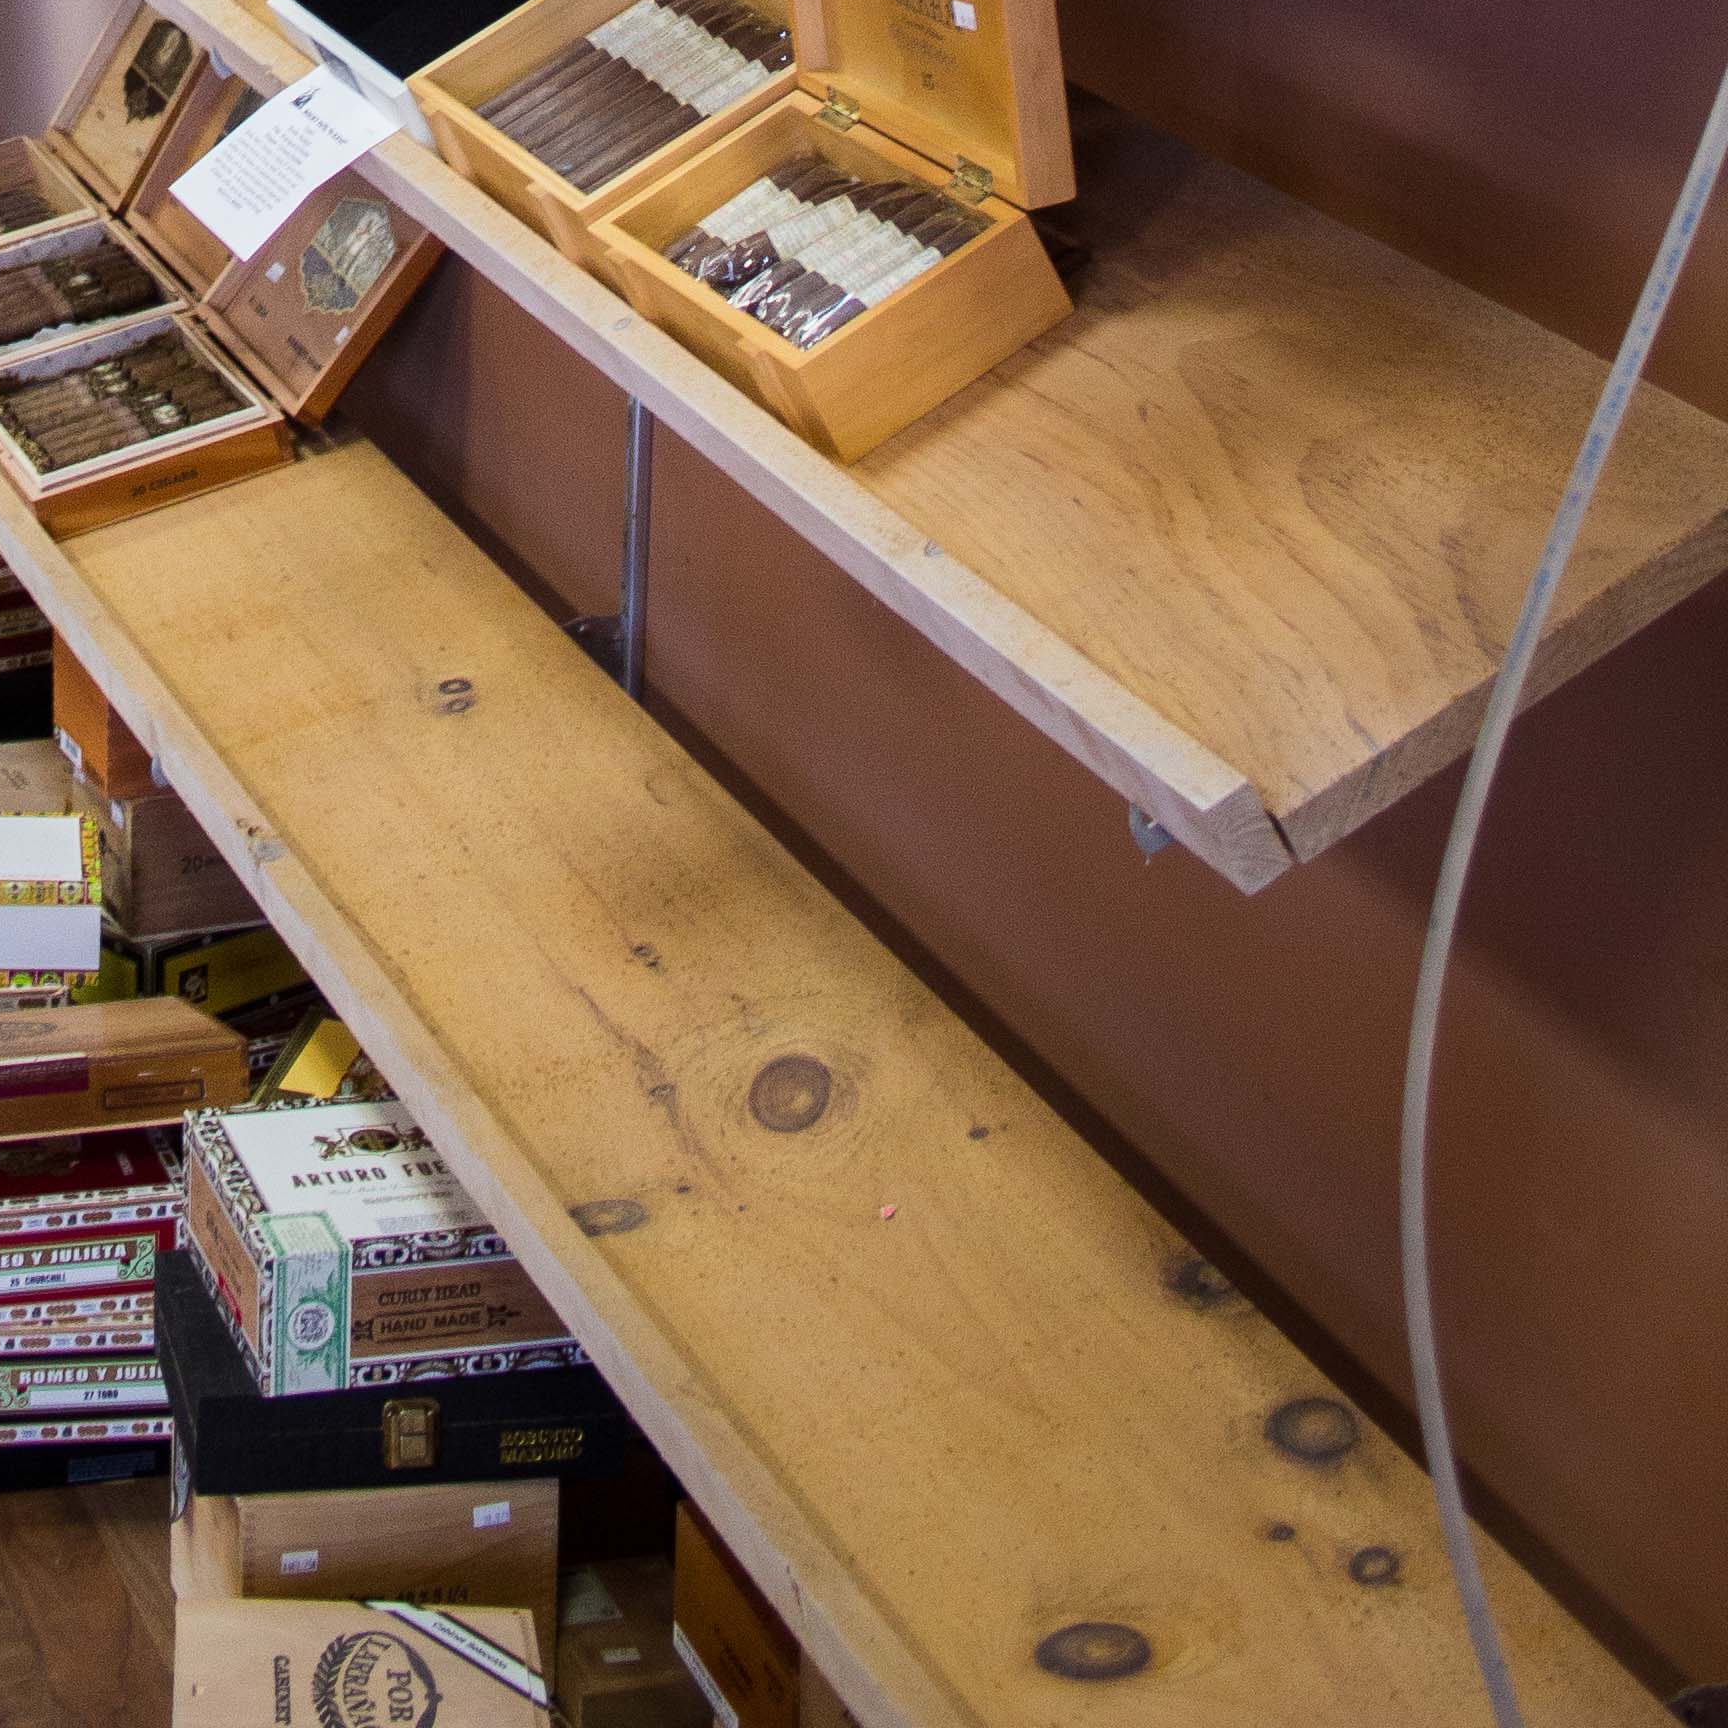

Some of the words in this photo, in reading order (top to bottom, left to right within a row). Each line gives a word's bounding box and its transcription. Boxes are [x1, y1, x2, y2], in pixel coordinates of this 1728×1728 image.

[290, 1165, 387, 1190] ARTURO
[403, 1158, 451, 1178] FUE
[30, 1250, 44, 1265] Y
[49, 1242, 128, 1264] JULIETA
[380, 1315, 426, 1335] HAND
[433, 1310, 482, 1330] MADE
[18, 1369, 90, 1386] ROMEO
[97, 1366, 109, 1382] Y
[114, 1365, 164, 1381] JULI
[498, 1444, 584, 1465] MADURO
[386, 1668, 413, 1723] POR
